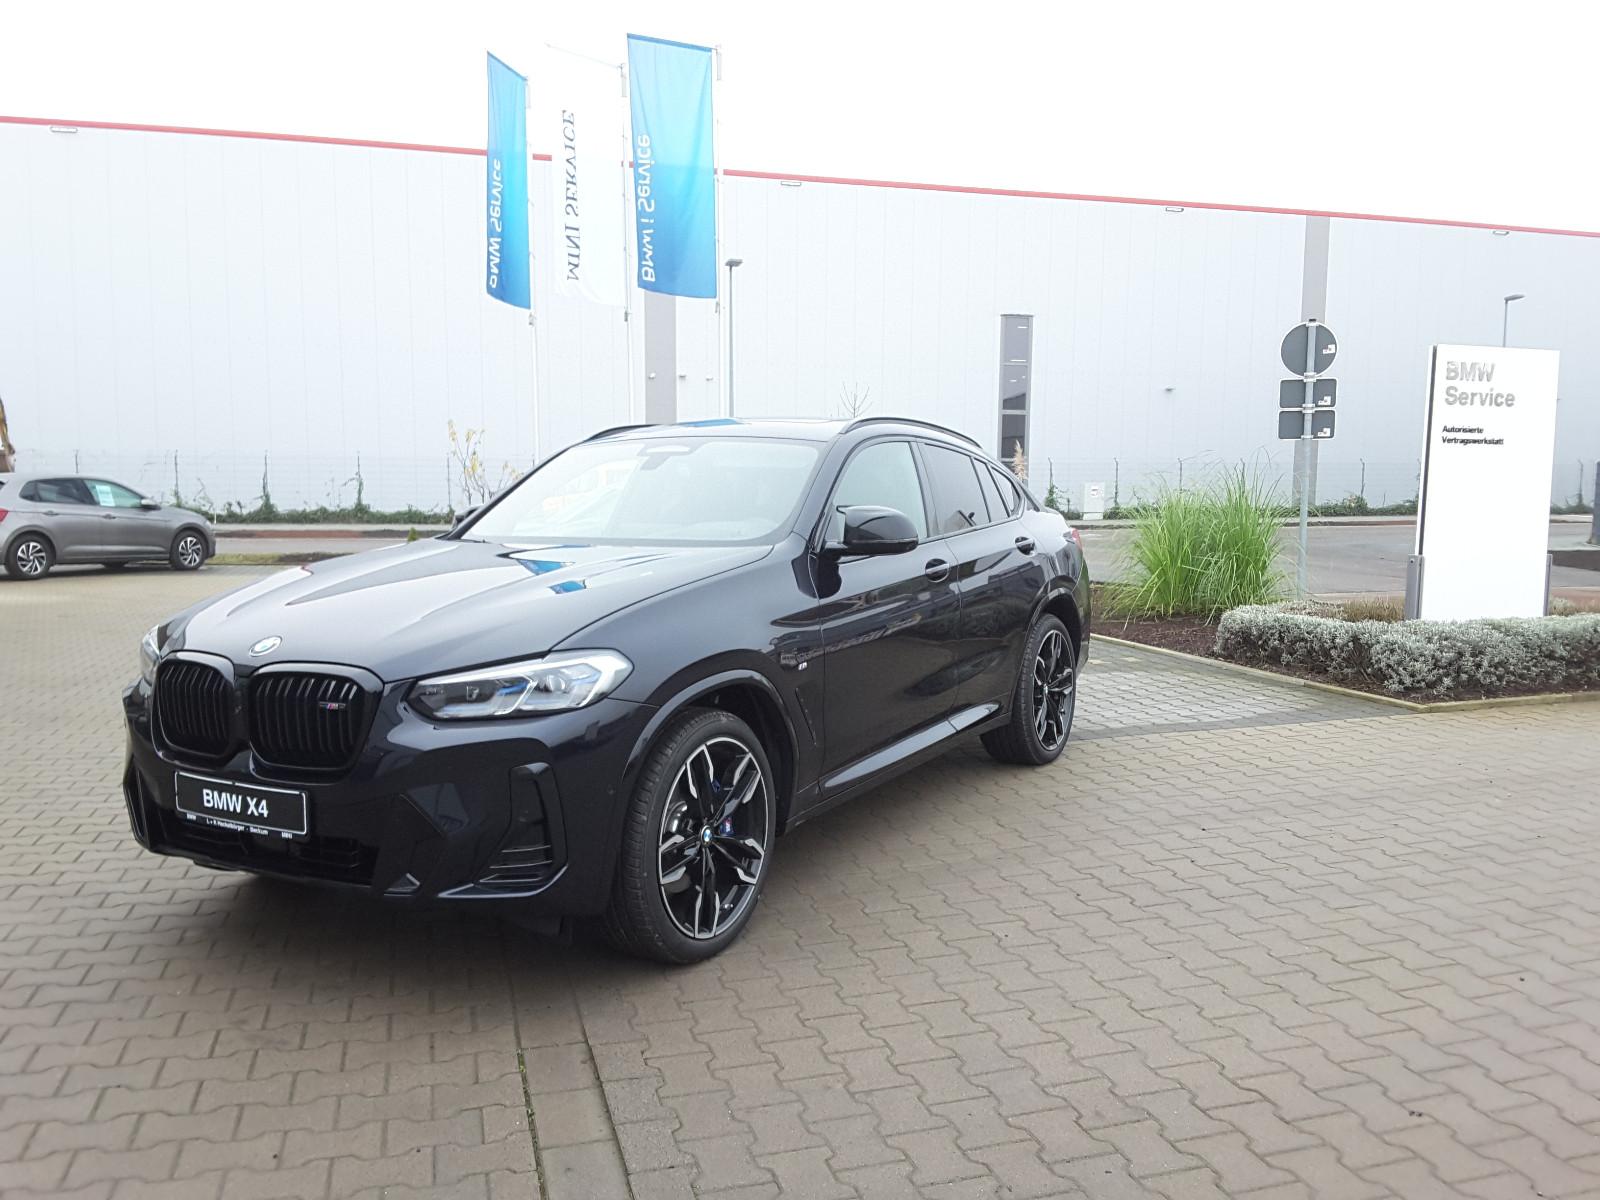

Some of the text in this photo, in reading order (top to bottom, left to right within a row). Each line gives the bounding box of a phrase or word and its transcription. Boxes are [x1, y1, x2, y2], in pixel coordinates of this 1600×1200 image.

[1445, 361, 1496, 382] BMW
[1444, 385, 1516, 407] Service
[202, 788, 269, 818] BMW X4
